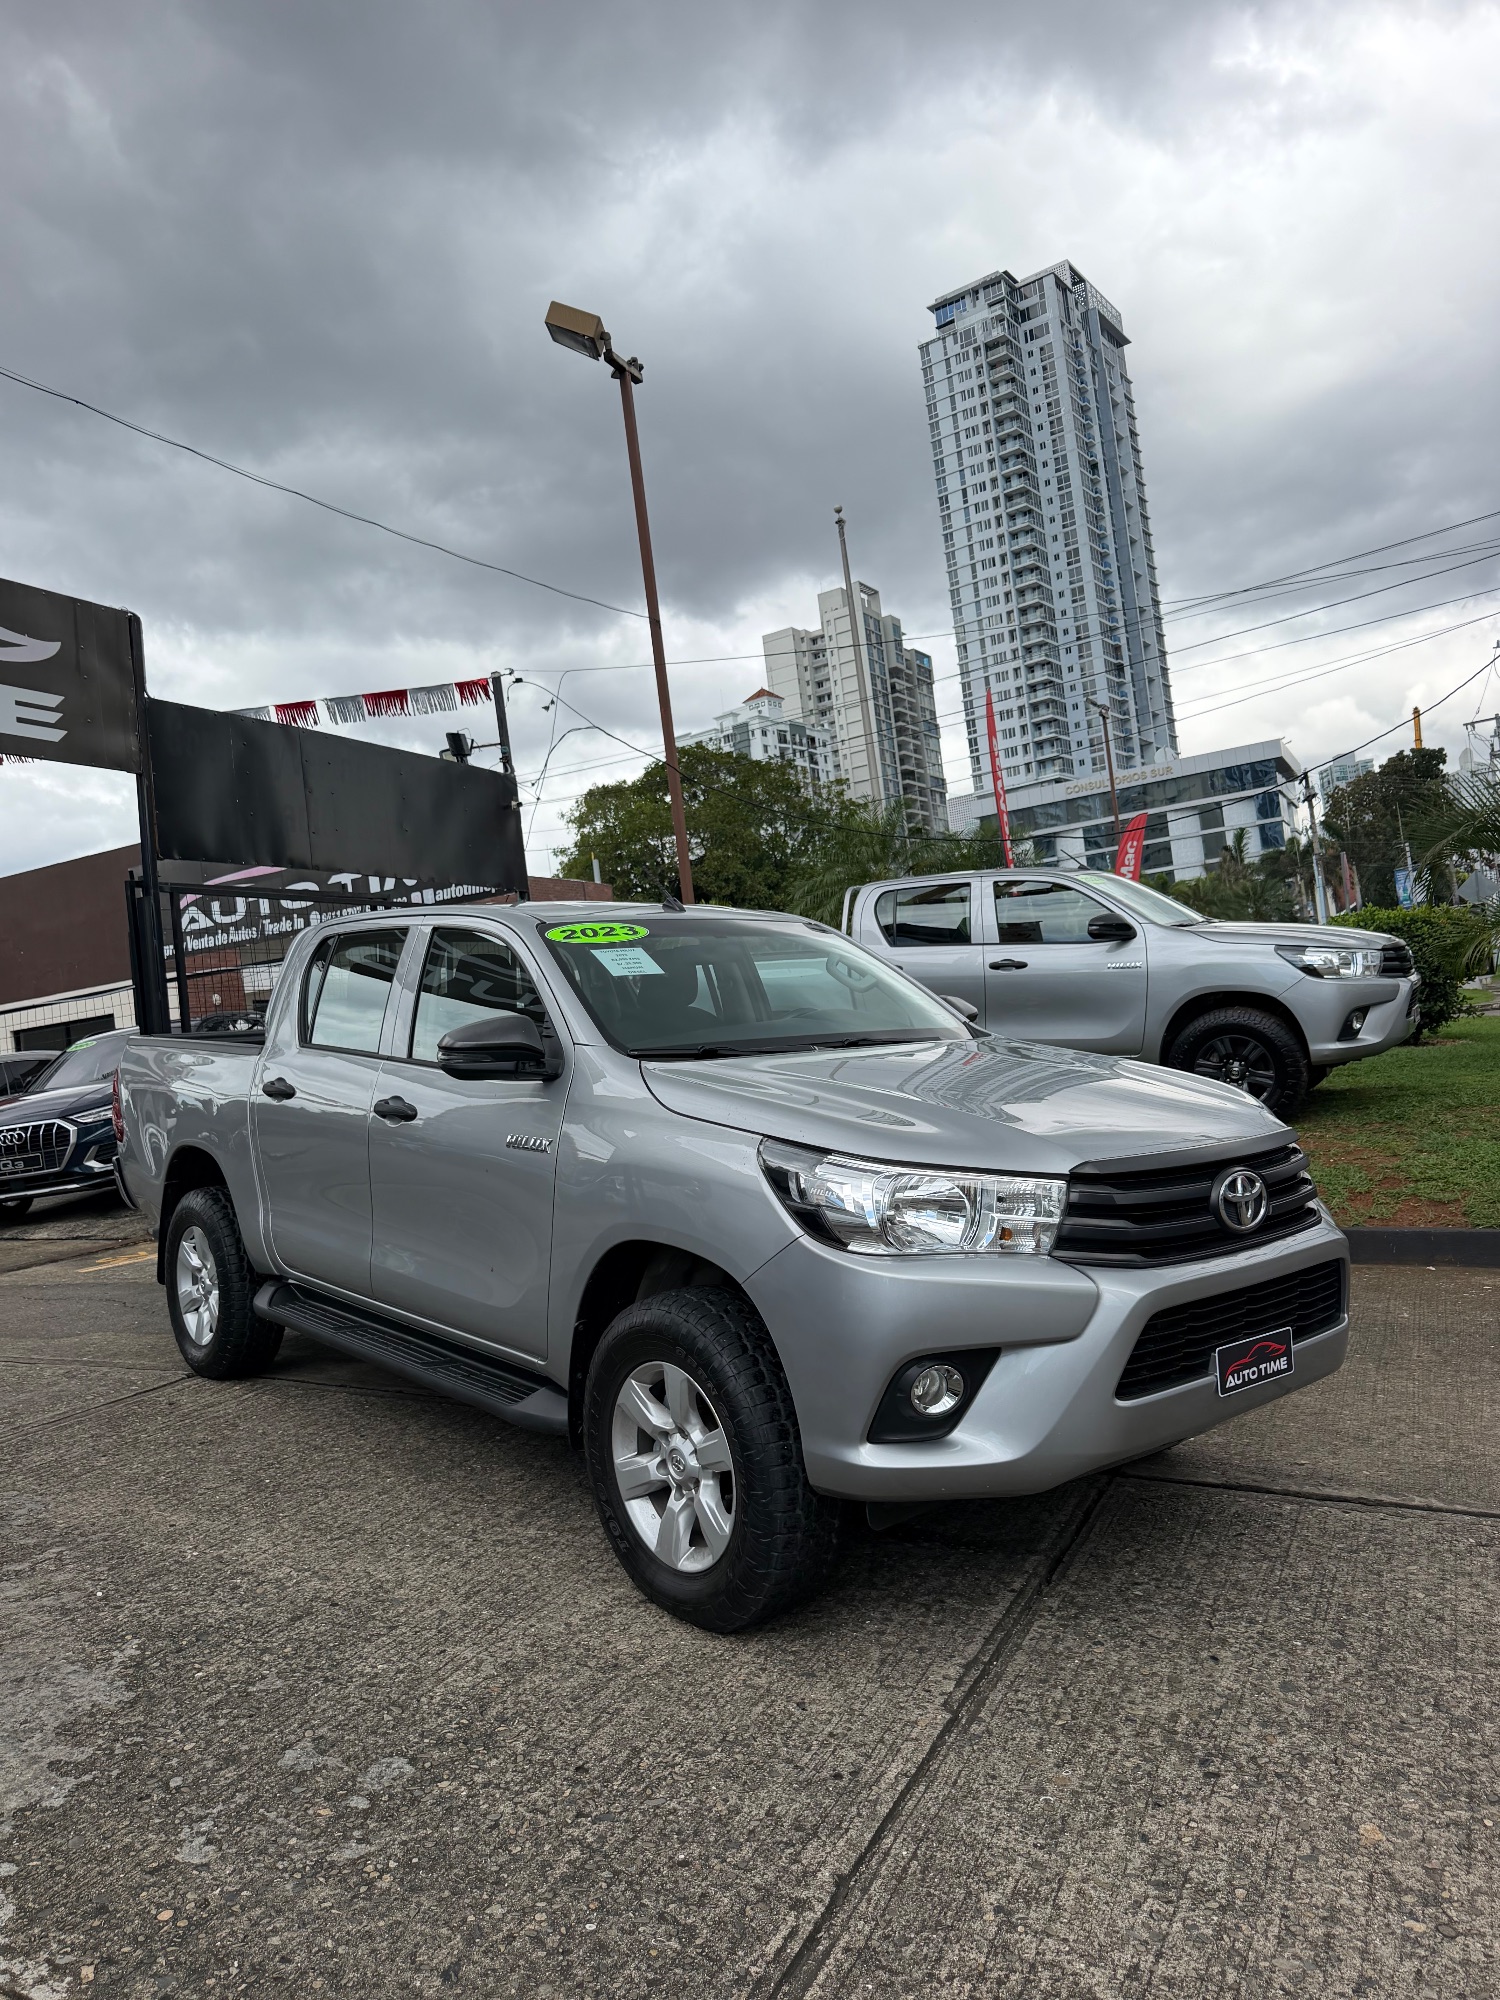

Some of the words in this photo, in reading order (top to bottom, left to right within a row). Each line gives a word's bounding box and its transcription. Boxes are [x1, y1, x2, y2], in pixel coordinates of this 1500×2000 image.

[1065, 771, 1148, 795] CONSULORIOS
[1150, 765, 1174, 779] SUR
[186, 934, 215, 952] Venta
[215, 929, 228, 946] de
[229, 926, 258, 944] Autos
[263, 916, 293, 935] Trade
[293, 914, 305, 930] in
[559, 926, 640, 940] 2023
[1107, 961, 1143, 970] HILUX
[506, 1133, 553, 1154] HILUX
[0, 1160, 25, 1171] Q3
[810, 1187, 840, 1199] HILUX
[1225, 1366, 1258, 1389] AUTO
[1259, 1356, 1288, 1377] TIME
